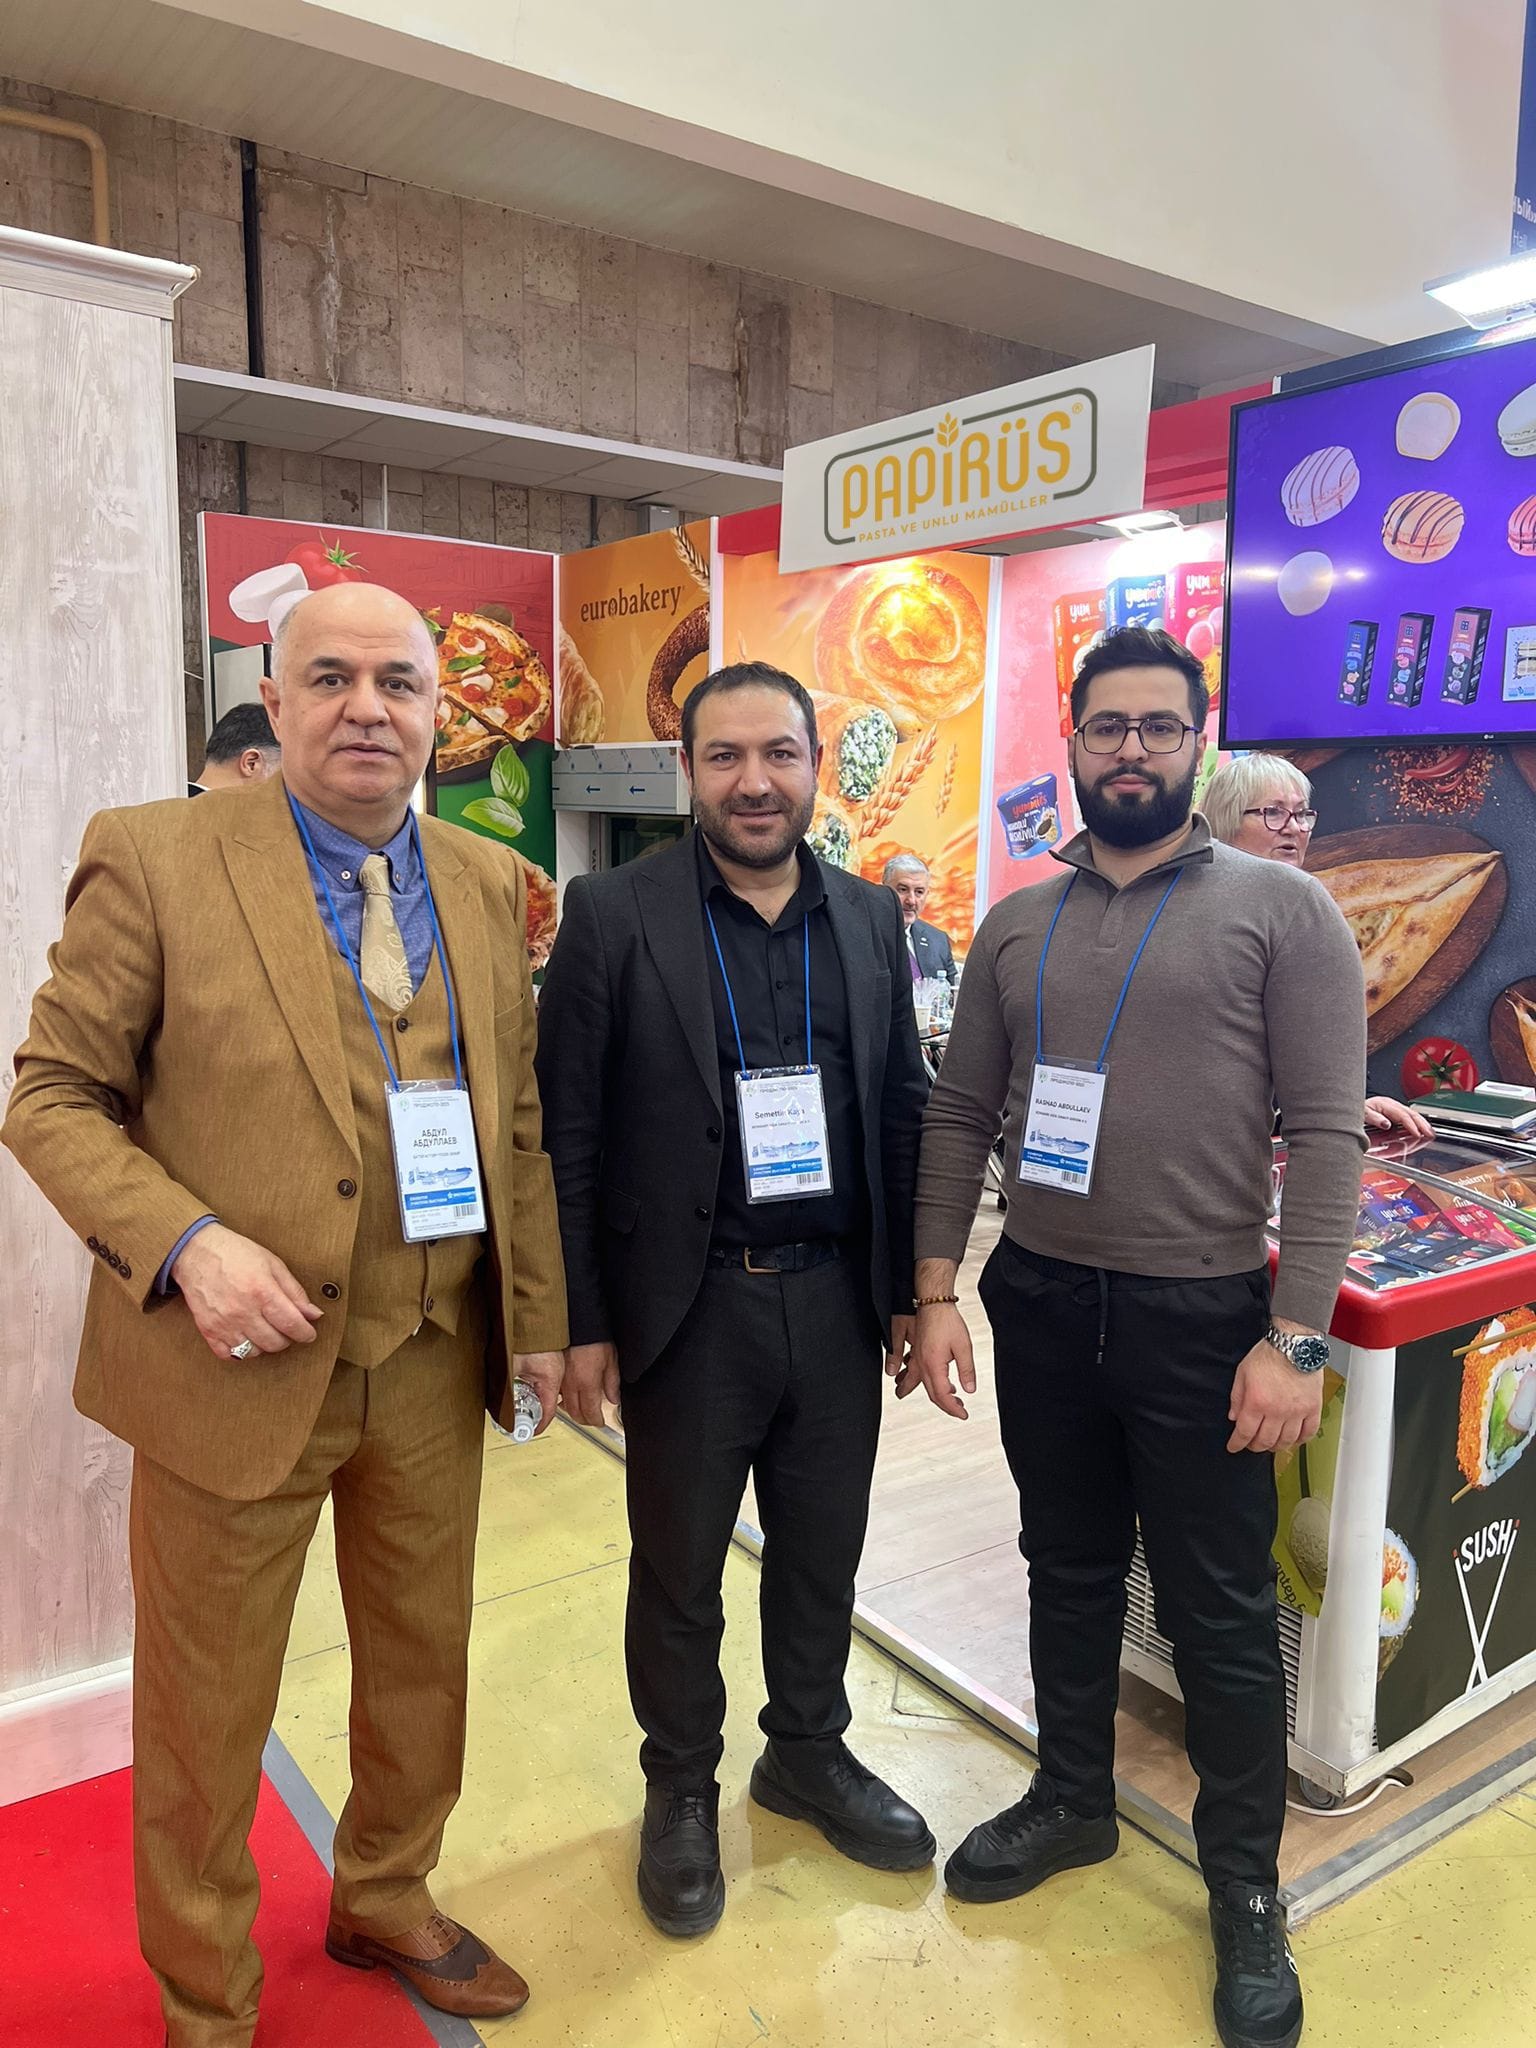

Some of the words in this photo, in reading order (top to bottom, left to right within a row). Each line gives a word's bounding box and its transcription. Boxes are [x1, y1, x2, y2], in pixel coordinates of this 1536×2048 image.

[858, 528, 896, 543] PASTA
[901, 522, 917, 534] VE
[922, 513, 960, 530] UNLU
[965, 494, 1049, 521] MAMÜLLER
[580, 583, 682, 622] eurobakery
[413, 1136, 457, 1148] АБДУЛЛАЕВ
[422, 1128, 447, 1138] АБДУЛ
